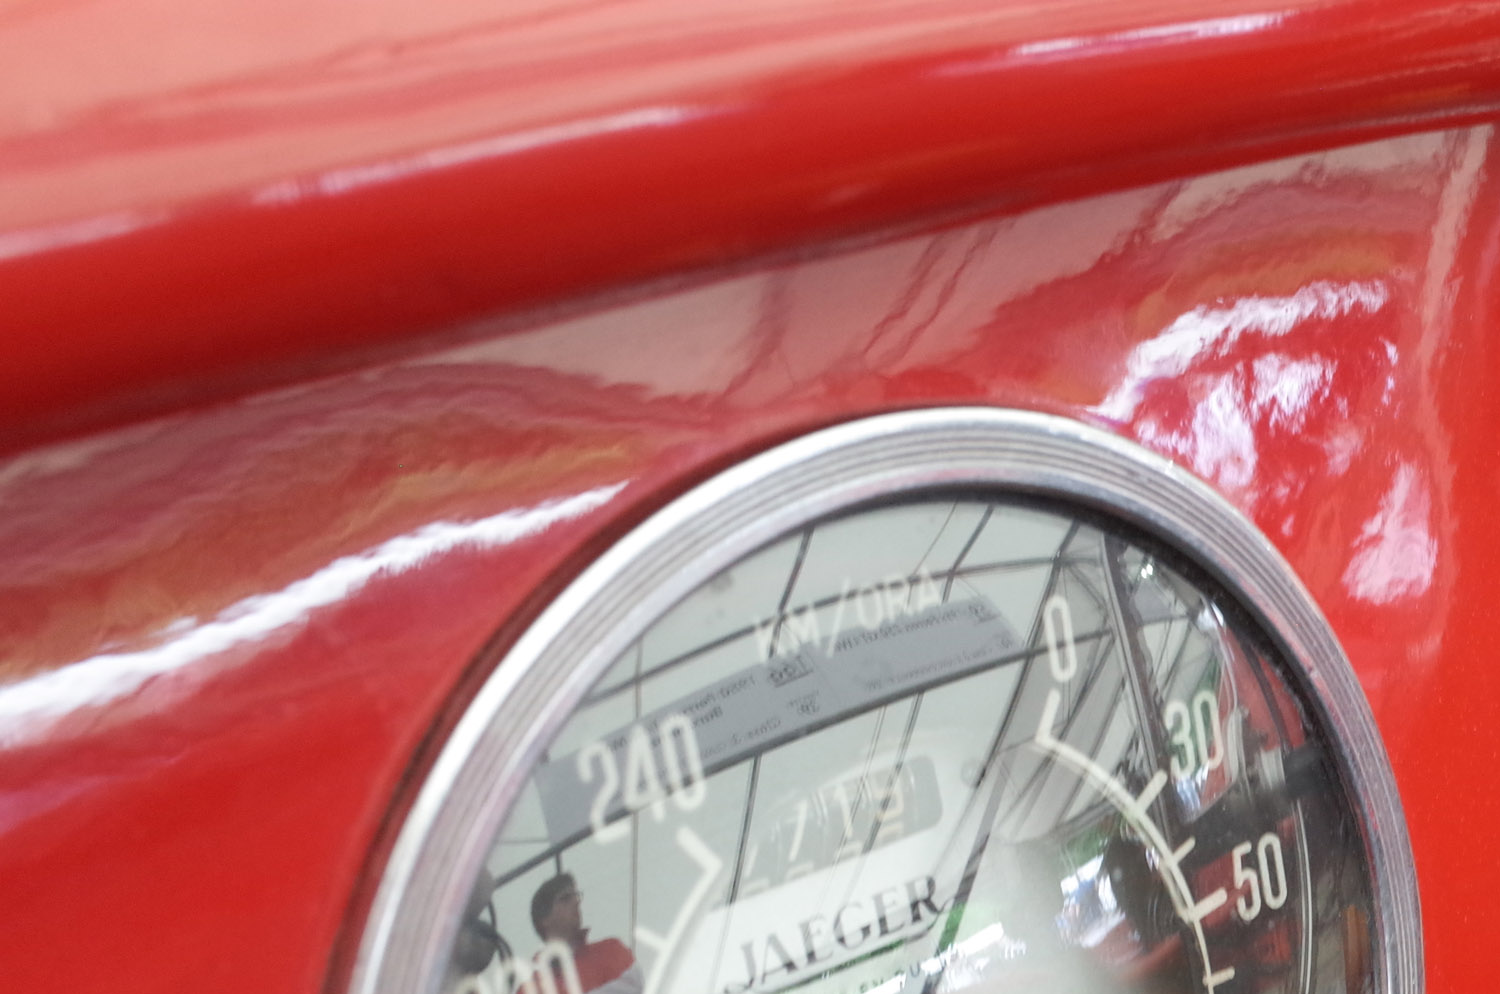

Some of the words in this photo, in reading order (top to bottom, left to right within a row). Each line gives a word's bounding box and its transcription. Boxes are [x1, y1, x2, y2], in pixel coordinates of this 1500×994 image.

[1043, 596, 1078, 684] 0
[1165, 691, 1224, 775] 30
[577, 714, 707, 844] 240
[1231, 830, 1289, 923] 50
